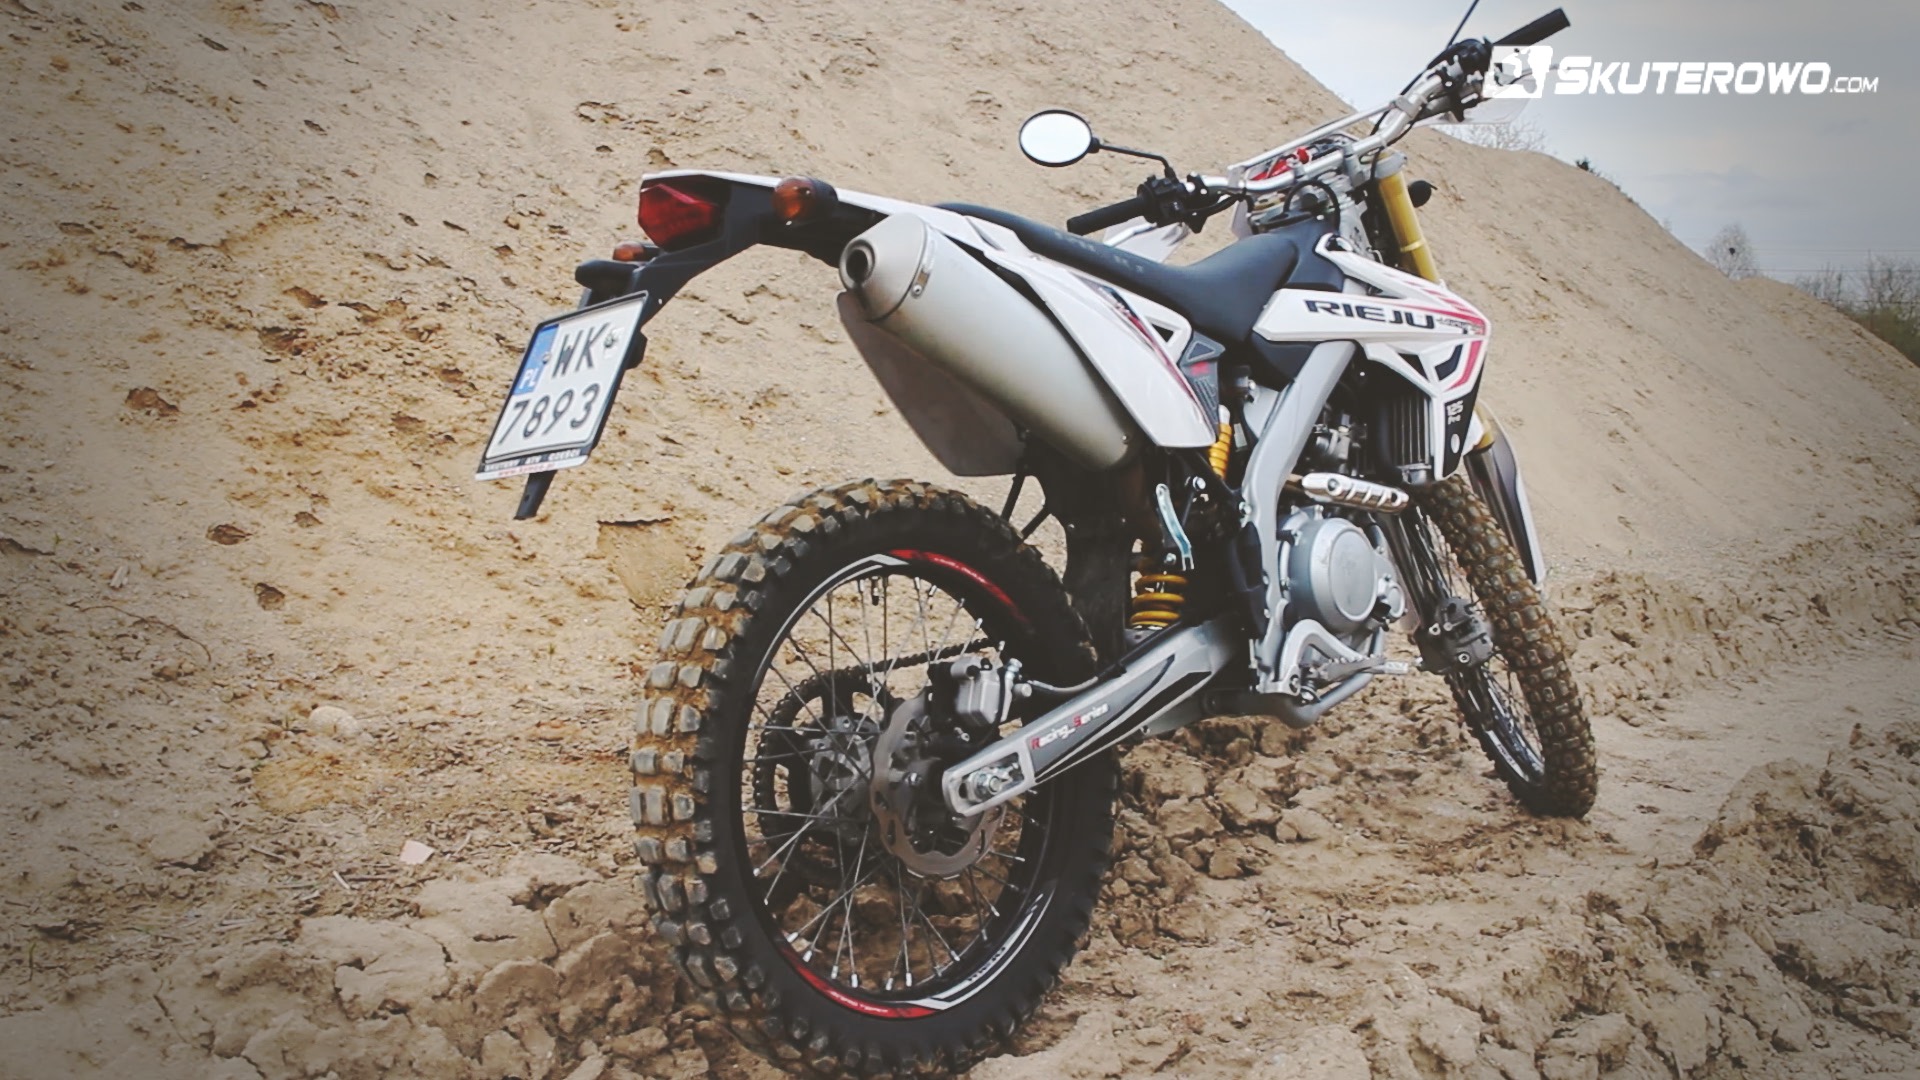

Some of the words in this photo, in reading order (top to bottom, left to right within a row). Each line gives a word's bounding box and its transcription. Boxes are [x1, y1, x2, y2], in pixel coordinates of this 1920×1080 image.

[1304, 300, 1435, 329] RIEJU
[552, 322, 610, 378] WK
[519, 368, 539, 389] PL
[498, 383, 600, 445] 7893
